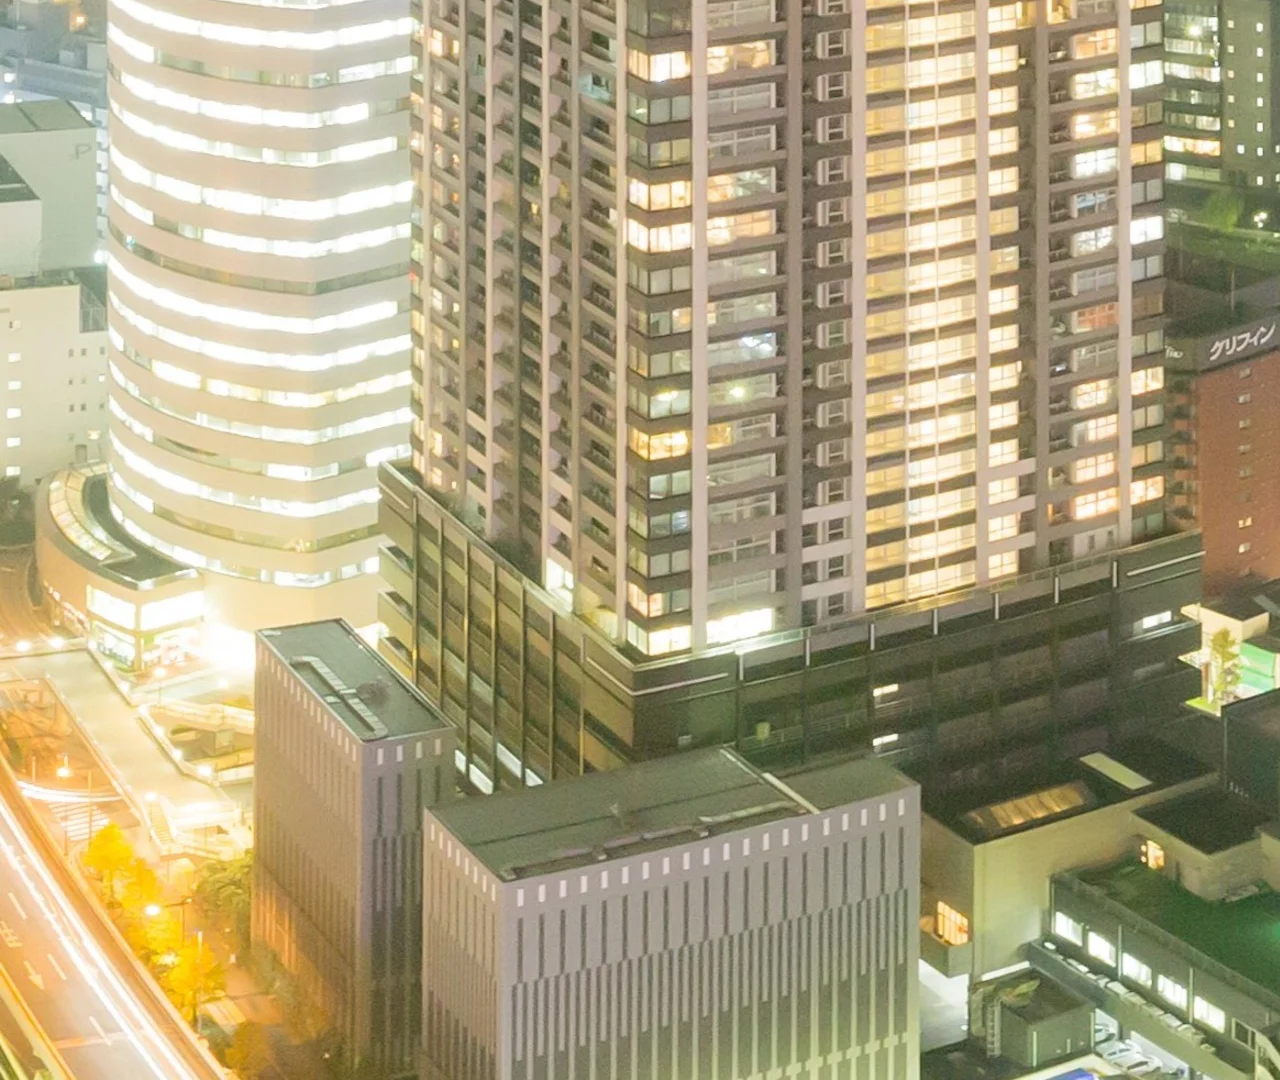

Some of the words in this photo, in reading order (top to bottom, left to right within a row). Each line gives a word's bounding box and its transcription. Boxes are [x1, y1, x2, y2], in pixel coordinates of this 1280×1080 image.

[1209, 321, 1276, 361] グリフィン
